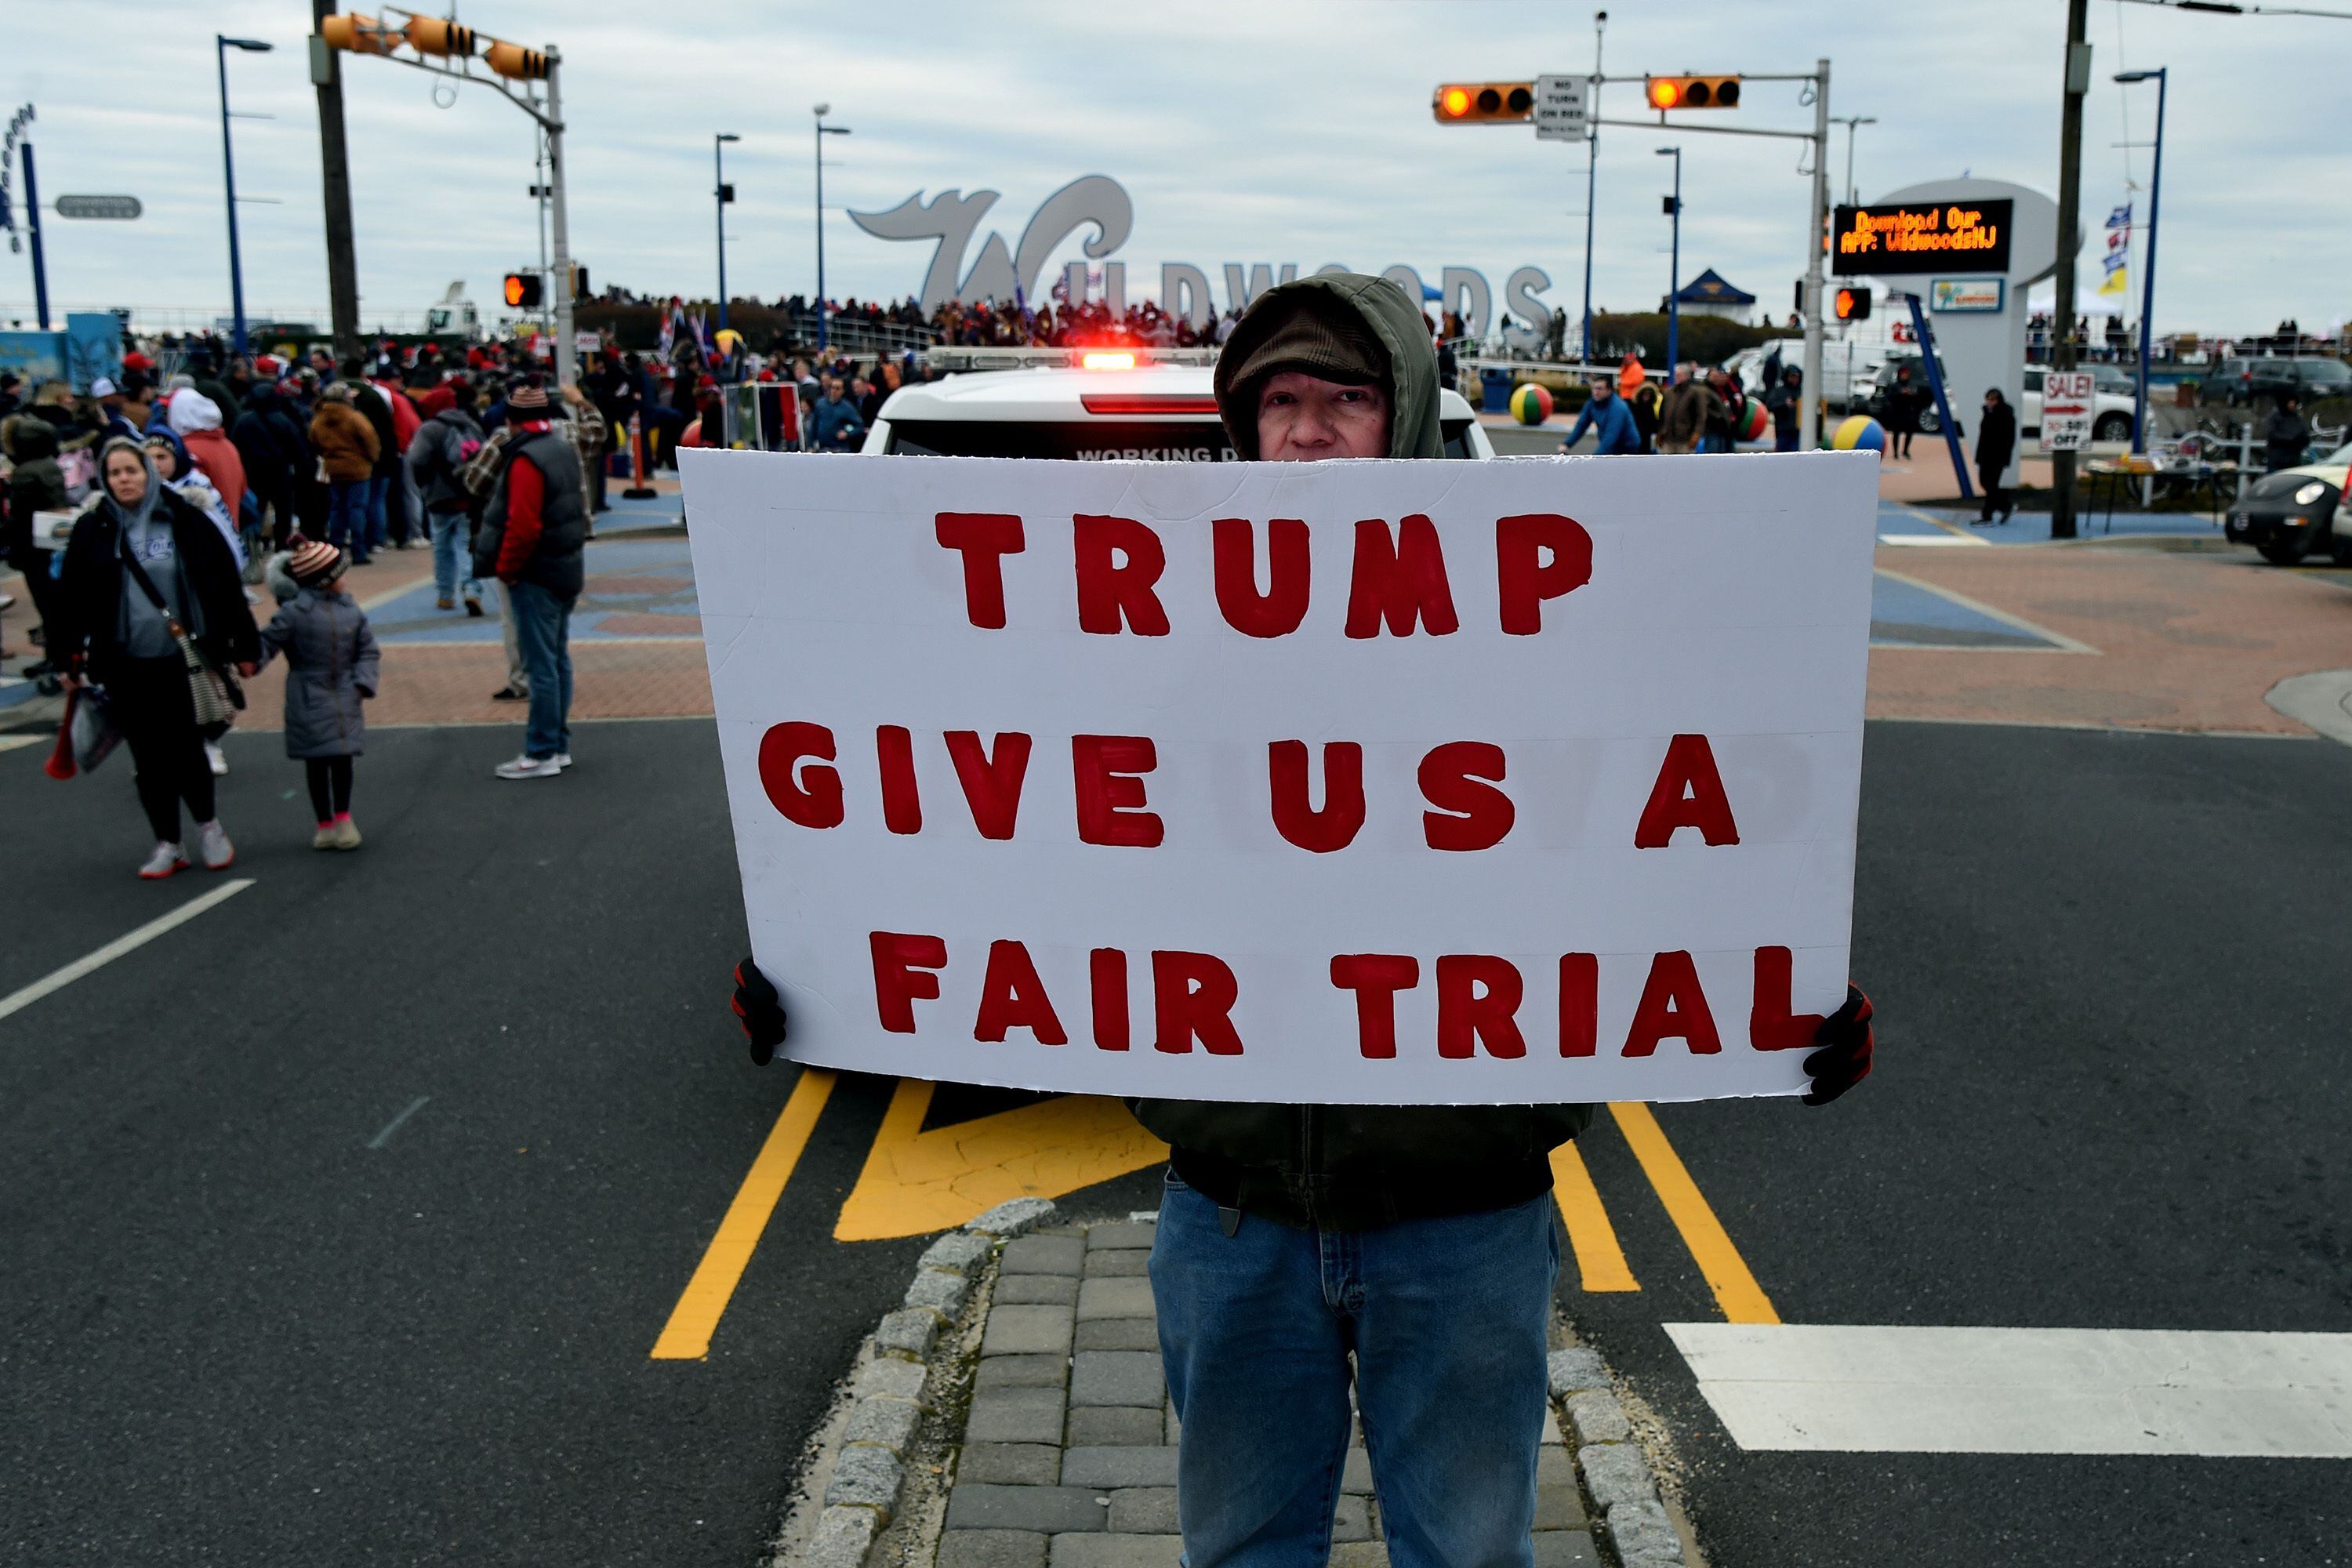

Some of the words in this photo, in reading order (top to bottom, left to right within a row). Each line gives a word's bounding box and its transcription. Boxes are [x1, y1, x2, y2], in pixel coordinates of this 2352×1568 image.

[1554, 81, 1572, 90] NO
[1547, 95, 1579, 104] TURN
[1541, 110, 1557, 118] ON
[1560, 110, 1584, 119] RED
[1856, 209, 1940, 233] Download
[1947, 206, 1982, 230] Our
[1076, 448, 1212, 462] WORKING
[935, 513, 1592, 639] TRUMP
[759, 721, 1163, 848] GIVE
[1269, 739, 1515, 852] US
[1635, 735, 1740, 848] A
[869, 931, 1243, 1054] FAIR
[1330, 946, 1831, 1058] TRIAL
